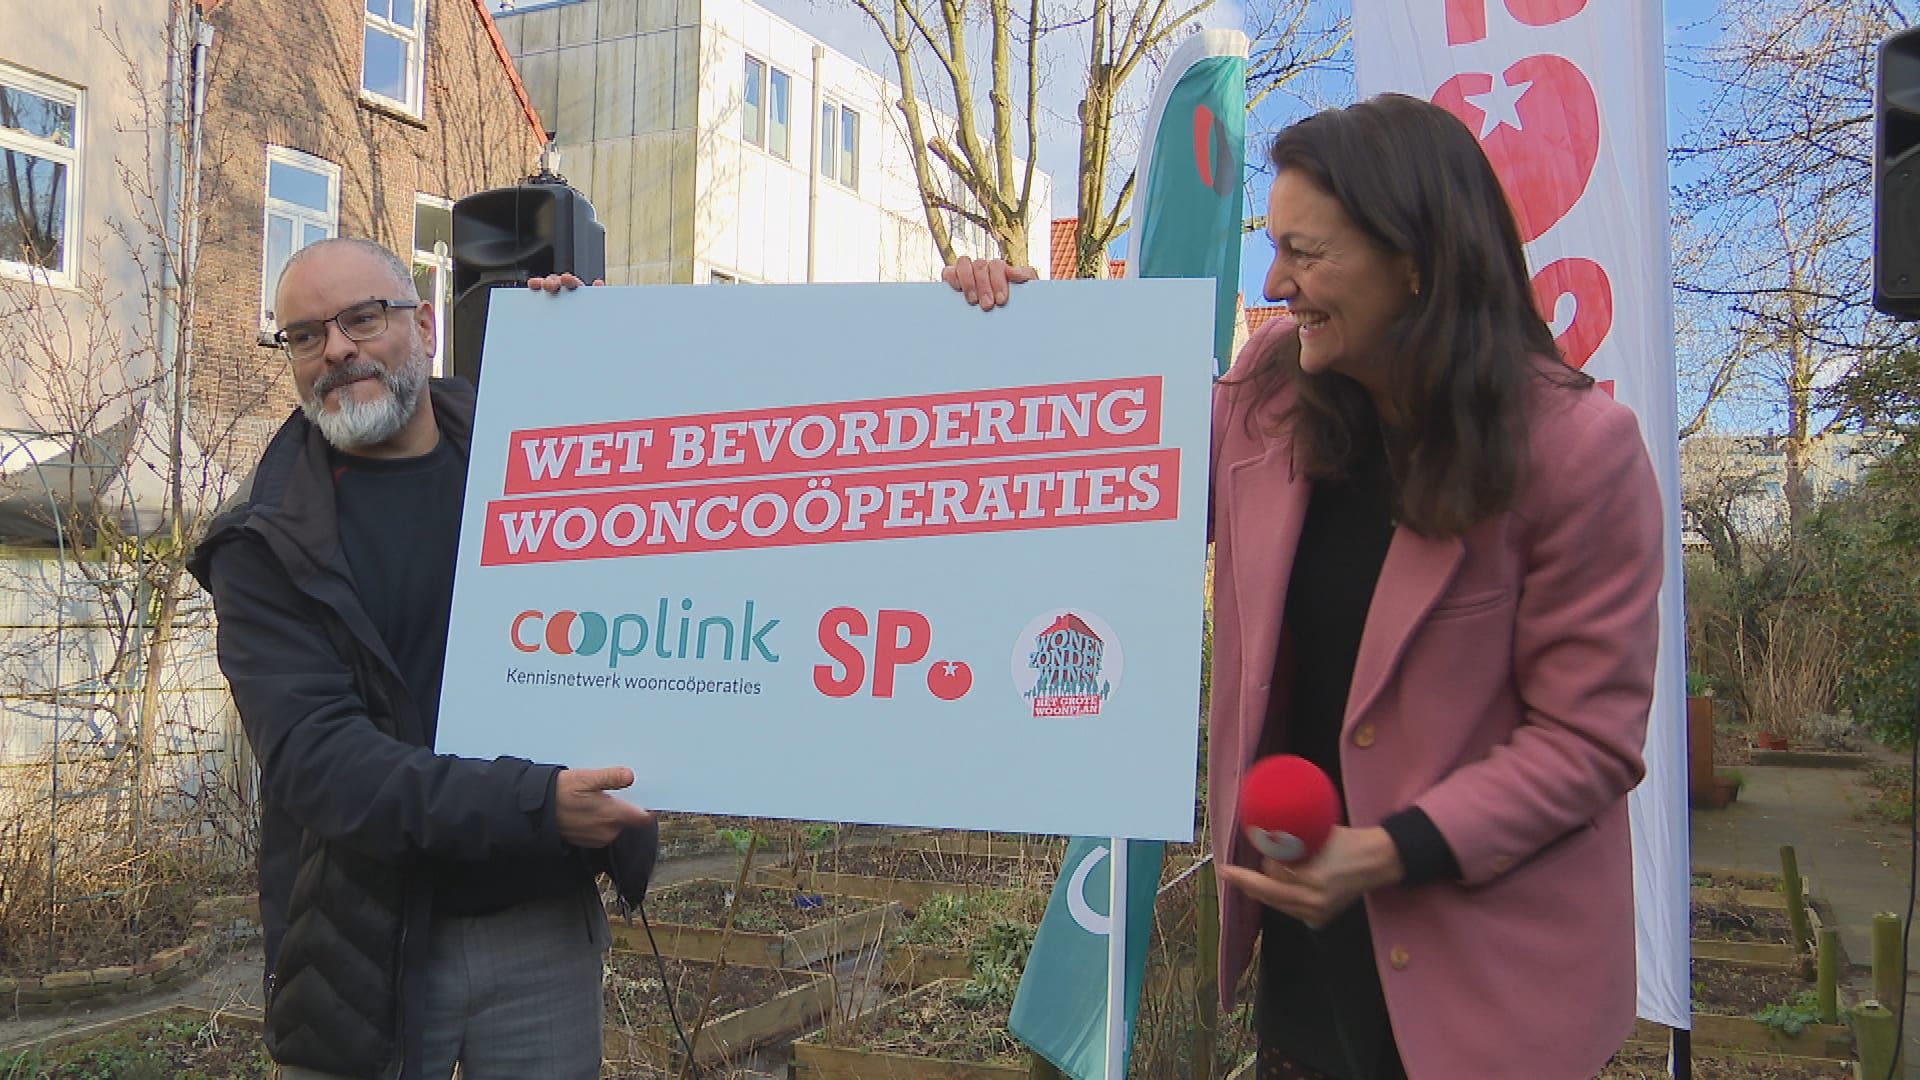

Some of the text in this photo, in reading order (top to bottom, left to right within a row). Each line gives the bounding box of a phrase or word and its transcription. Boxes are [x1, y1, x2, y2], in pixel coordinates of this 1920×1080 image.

[521, 388, 1148, 482] WET BEVORDERING
[499, 464, 1161, 554] WOONCOÖPERATIES
[510, 597, 781, 669] cooplink
[1035, 630, 1104, 656] WONEN
[506, 667, 761, 695] Kennisnetwerk wooncoöperaties
[1028, 648, 1103, 670] ZONDER
